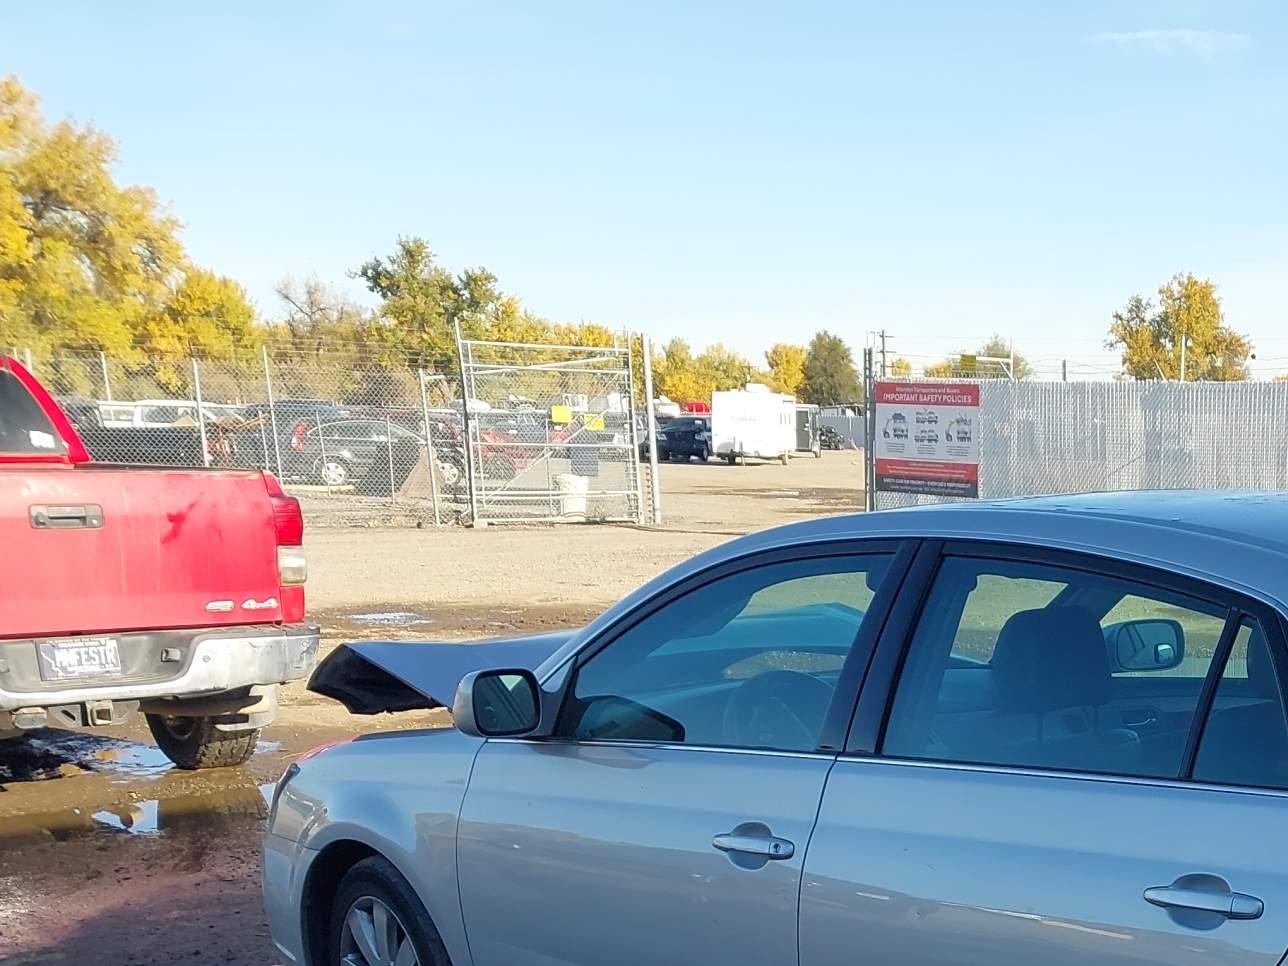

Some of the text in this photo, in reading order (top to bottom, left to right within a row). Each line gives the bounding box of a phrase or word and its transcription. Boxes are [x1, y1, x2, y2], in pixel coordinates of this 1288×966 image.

[882, 392, 972, 403] IMPORTANT SAFETY POLICIES
